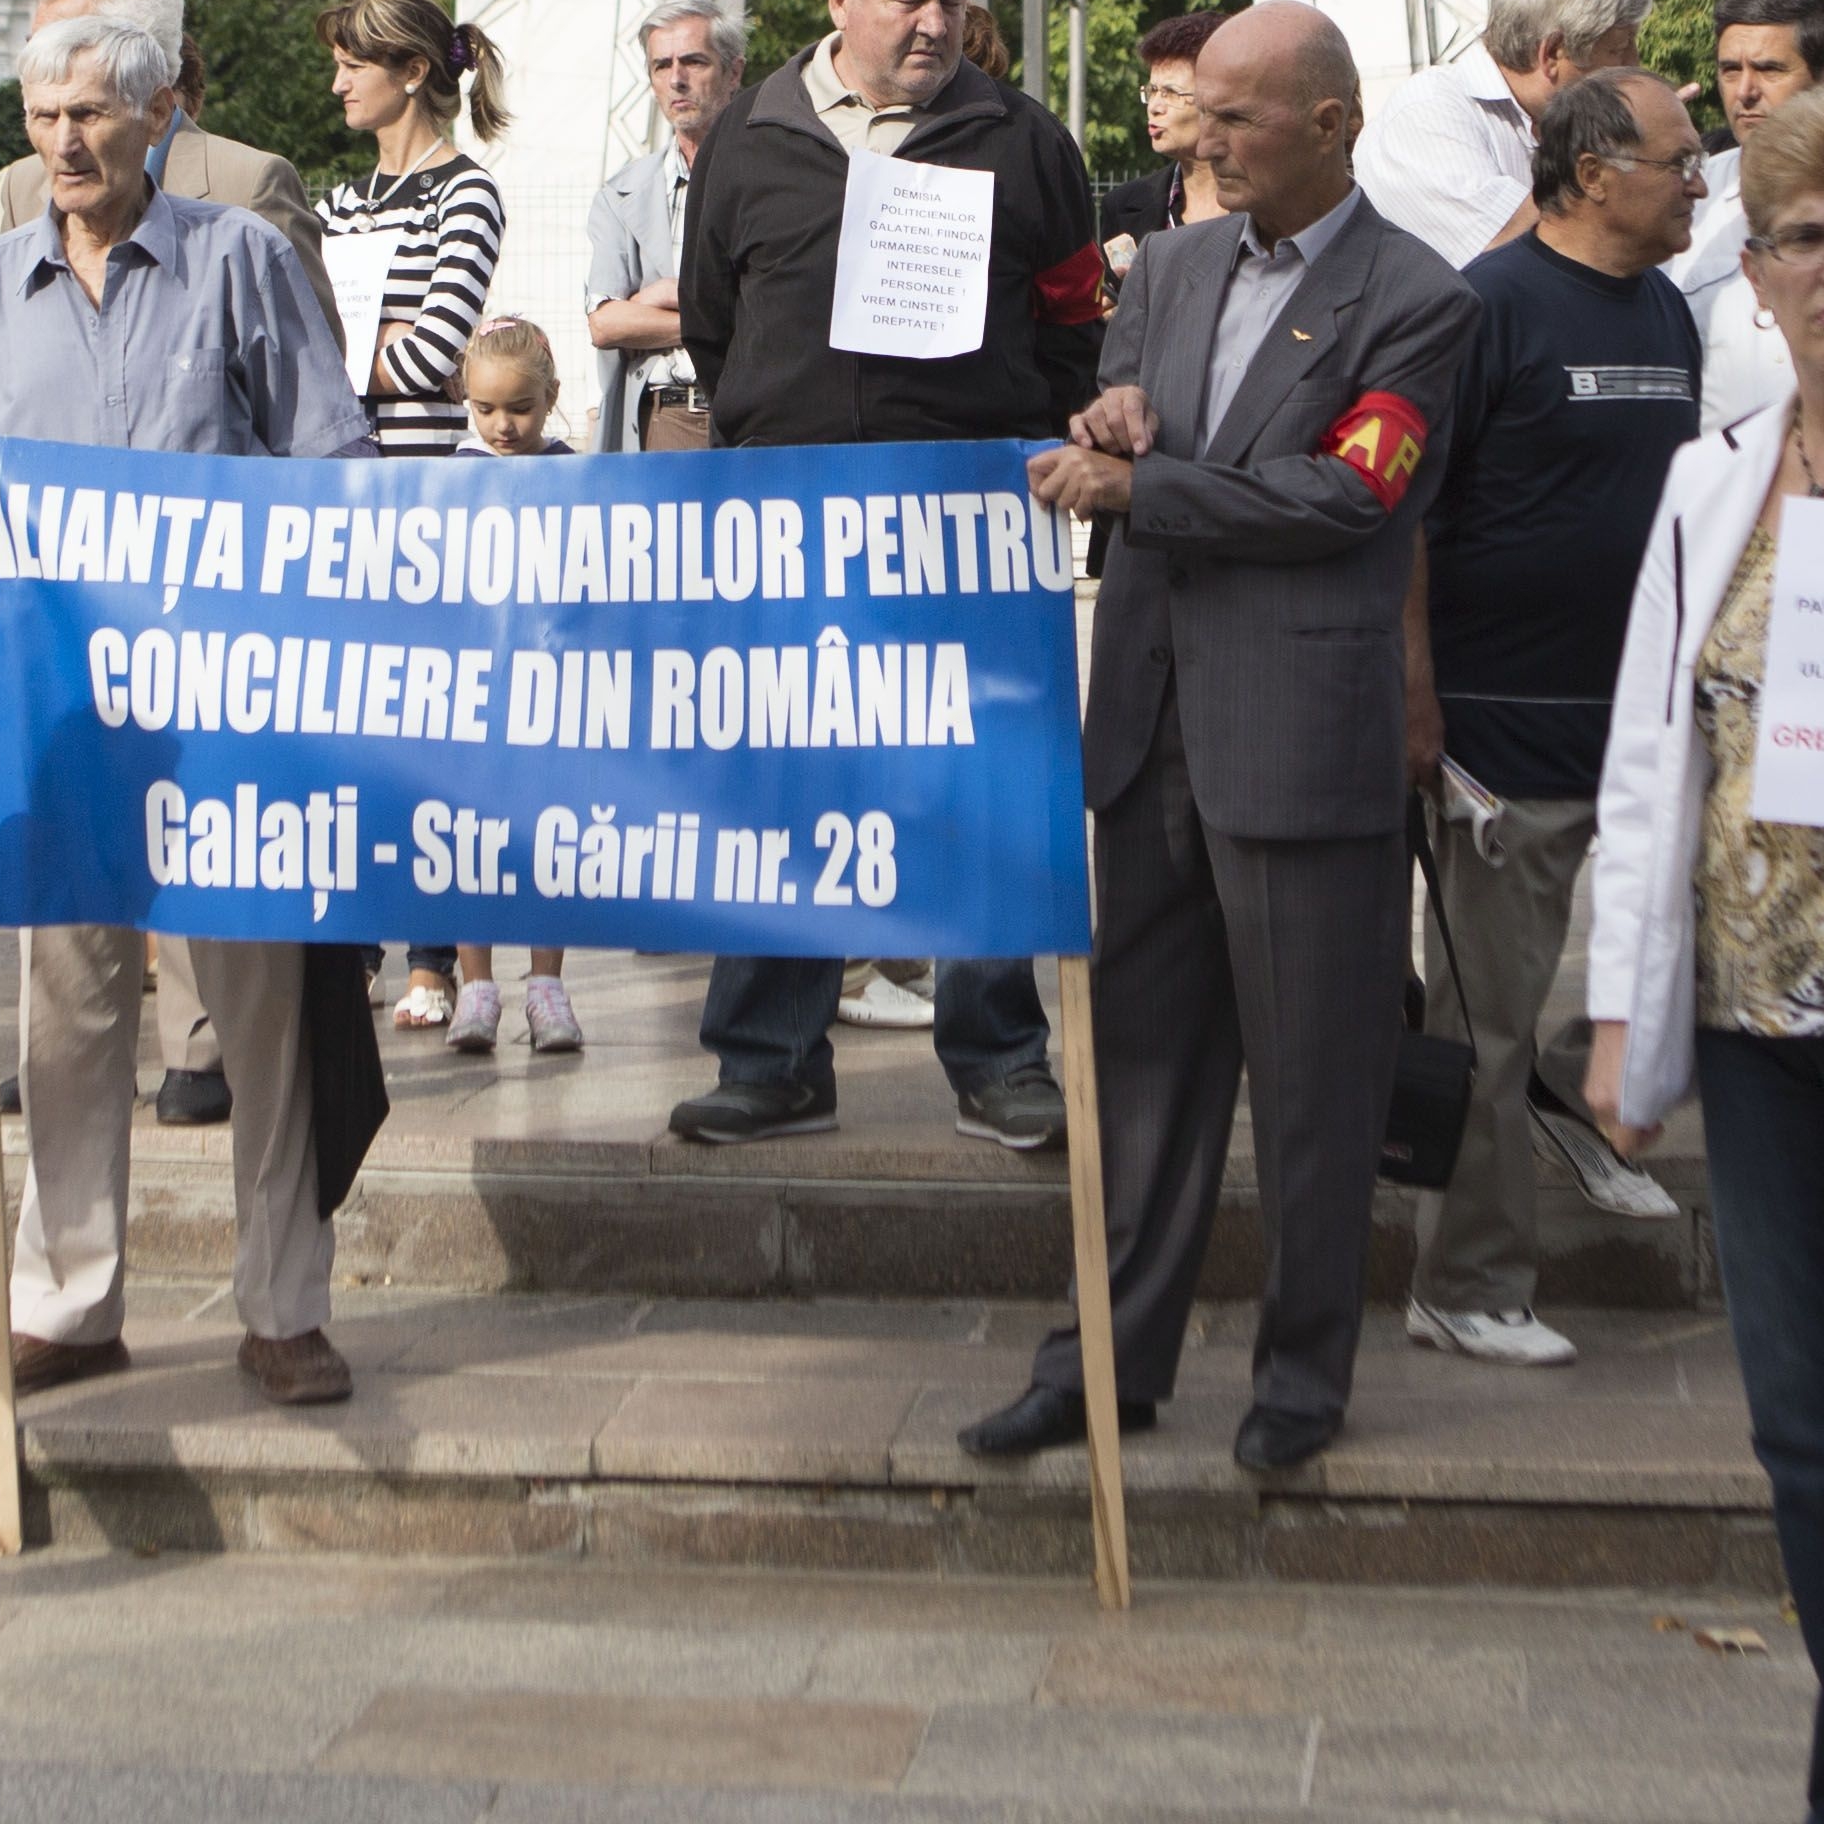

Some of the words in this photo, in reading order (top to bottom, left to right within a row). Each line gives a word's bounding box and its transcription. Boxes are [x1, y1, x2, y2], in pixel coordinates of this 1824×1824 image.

[893, 186, 942, 202] DEMISIA
[881, 204, 976, 223] POLITICIENILOR
[869, 220, 934, 238] GALATENI,
[937, 228, 985, 243] FIINDCA
[870, 240, 939, 256] URMARESC
[942, 248, 982, 262] NUMAI
[887, 260, 962, 278] INTERESELE
[881, 279, 955, 296] PERSONALE
[861, 294, 896, 306] VREM
[899, 299, 944, 313] CINSTE
[947, 305, 959, 314] SI
[872, 314, 938, 331] DREPTATE
[260, 499, 805, 605] PENSIONARILOR
[823, 492, 1073, 598] PENTRU
[88, 627, 493, 743] CONCILIERE
[506, 649, 632, 749] DIN
[651, 625, 975, 751] ROMÂNIA
[145, 779, 358, 923] Galați
[374, 843, 397, 864] -
[412, 799, 517, 895] Str.
[533, 804, 700, 900] Gării
[714, 827, 797, 904] nr.
[813, 810, 897, 908] 28
